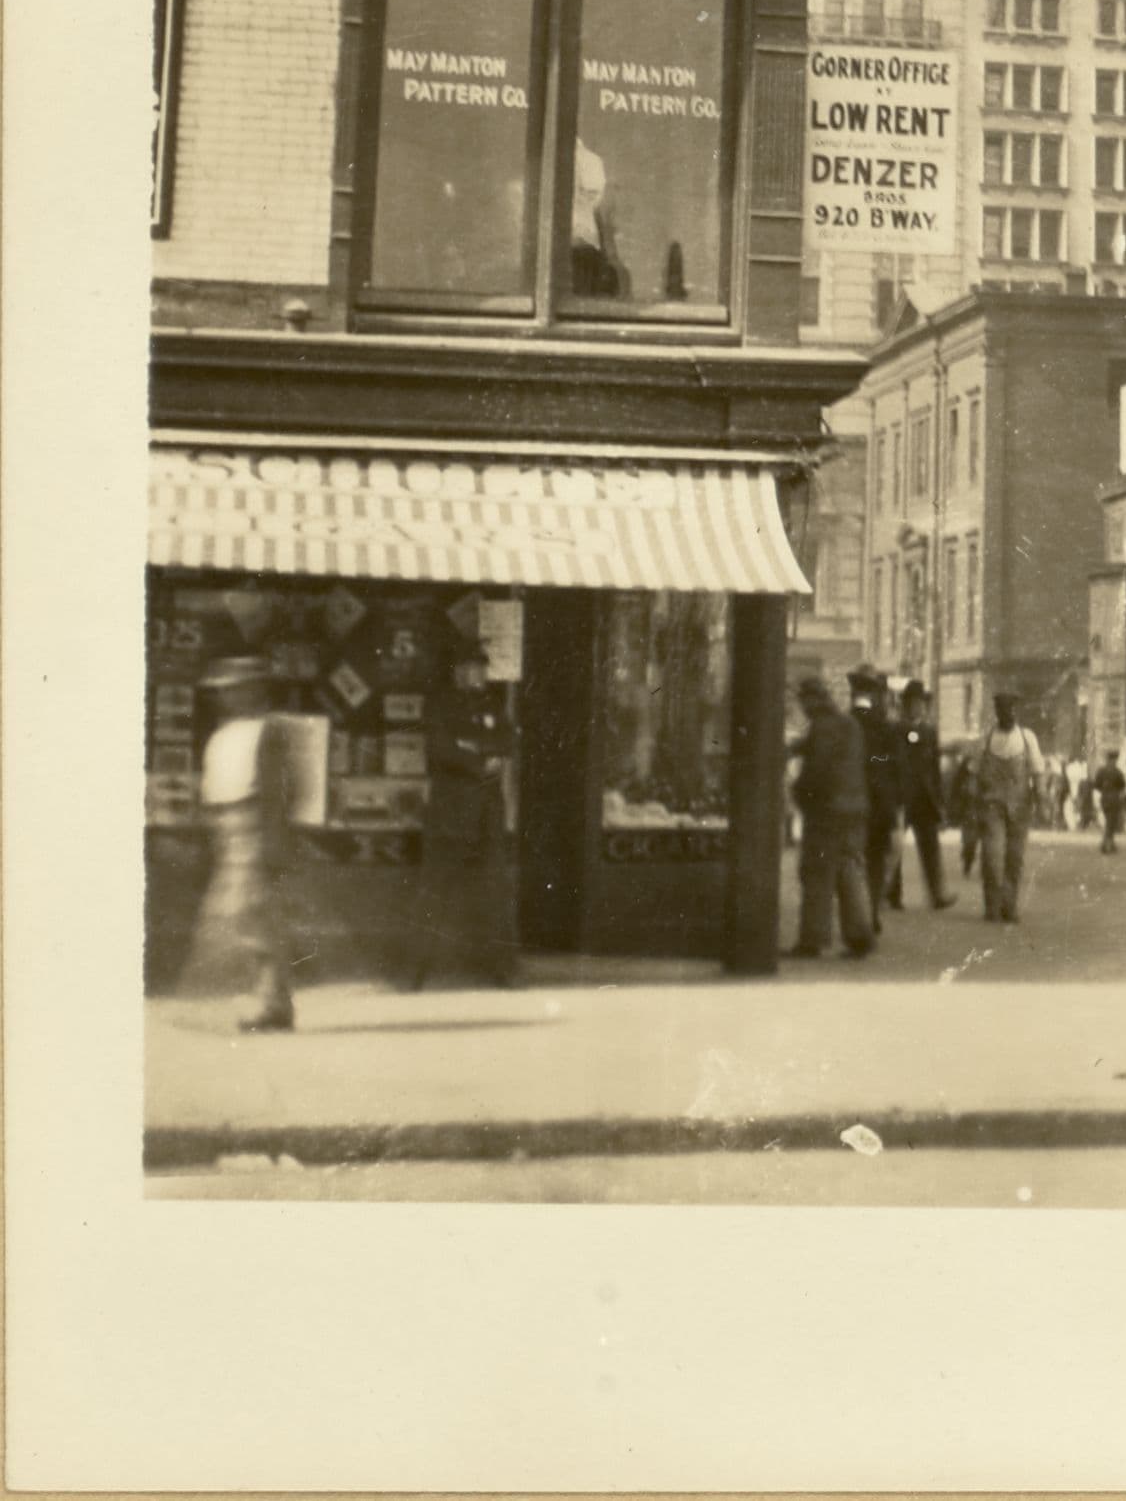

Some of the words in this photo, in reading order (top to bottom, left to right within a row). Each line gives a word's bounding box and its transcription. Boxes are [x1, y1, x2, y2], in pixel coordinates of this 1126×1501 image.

[386, 49, 428, 72] MAY
[430, 51, 506, 77] MANTON
[583, 59, 620, 82] MAY
[622, 61, 696, 88] MANTON
[811, 51, 885, 81] CORNER
[888, 56, 950, 85] OFFICE
[404, 78, 498, 106] PATTERN
[600, 89, 686, 116] PATTERN
[811, 100, 868, 132] LOW
[876, 104, 950, 137] RENT
[811, 154, 938, 189] DENZER
[815, 205, 859, 227] 920
